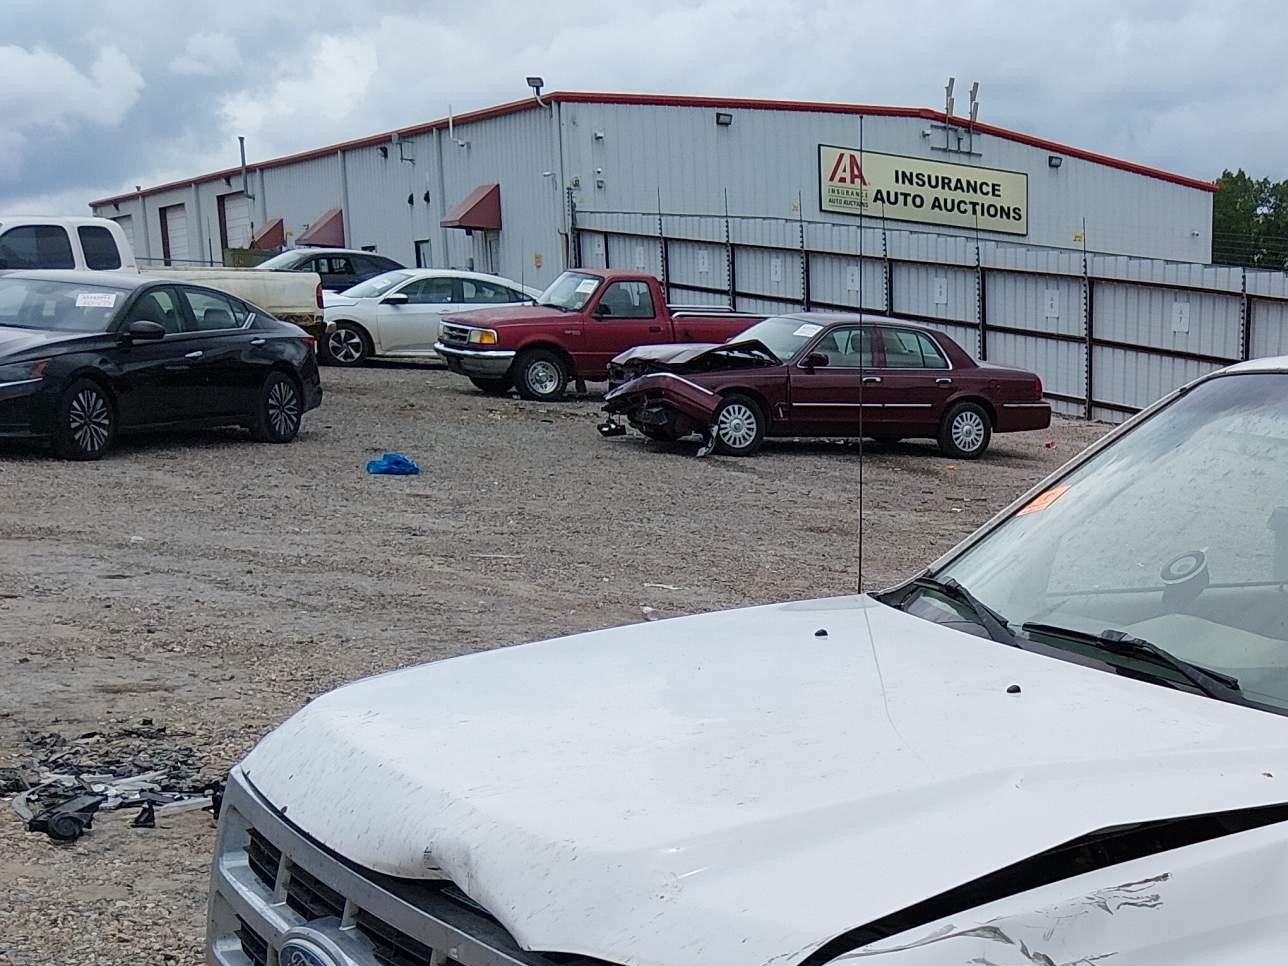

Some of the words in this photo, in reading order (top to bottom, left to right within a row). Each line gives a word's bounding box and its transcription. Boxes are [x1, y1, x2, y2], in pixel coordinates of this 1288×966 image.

[893, 169, 1002, 198] INSURANCE
[872, 188, 925, 209] AUTO
[930, 196, 1023, 221] AUCTIONS
